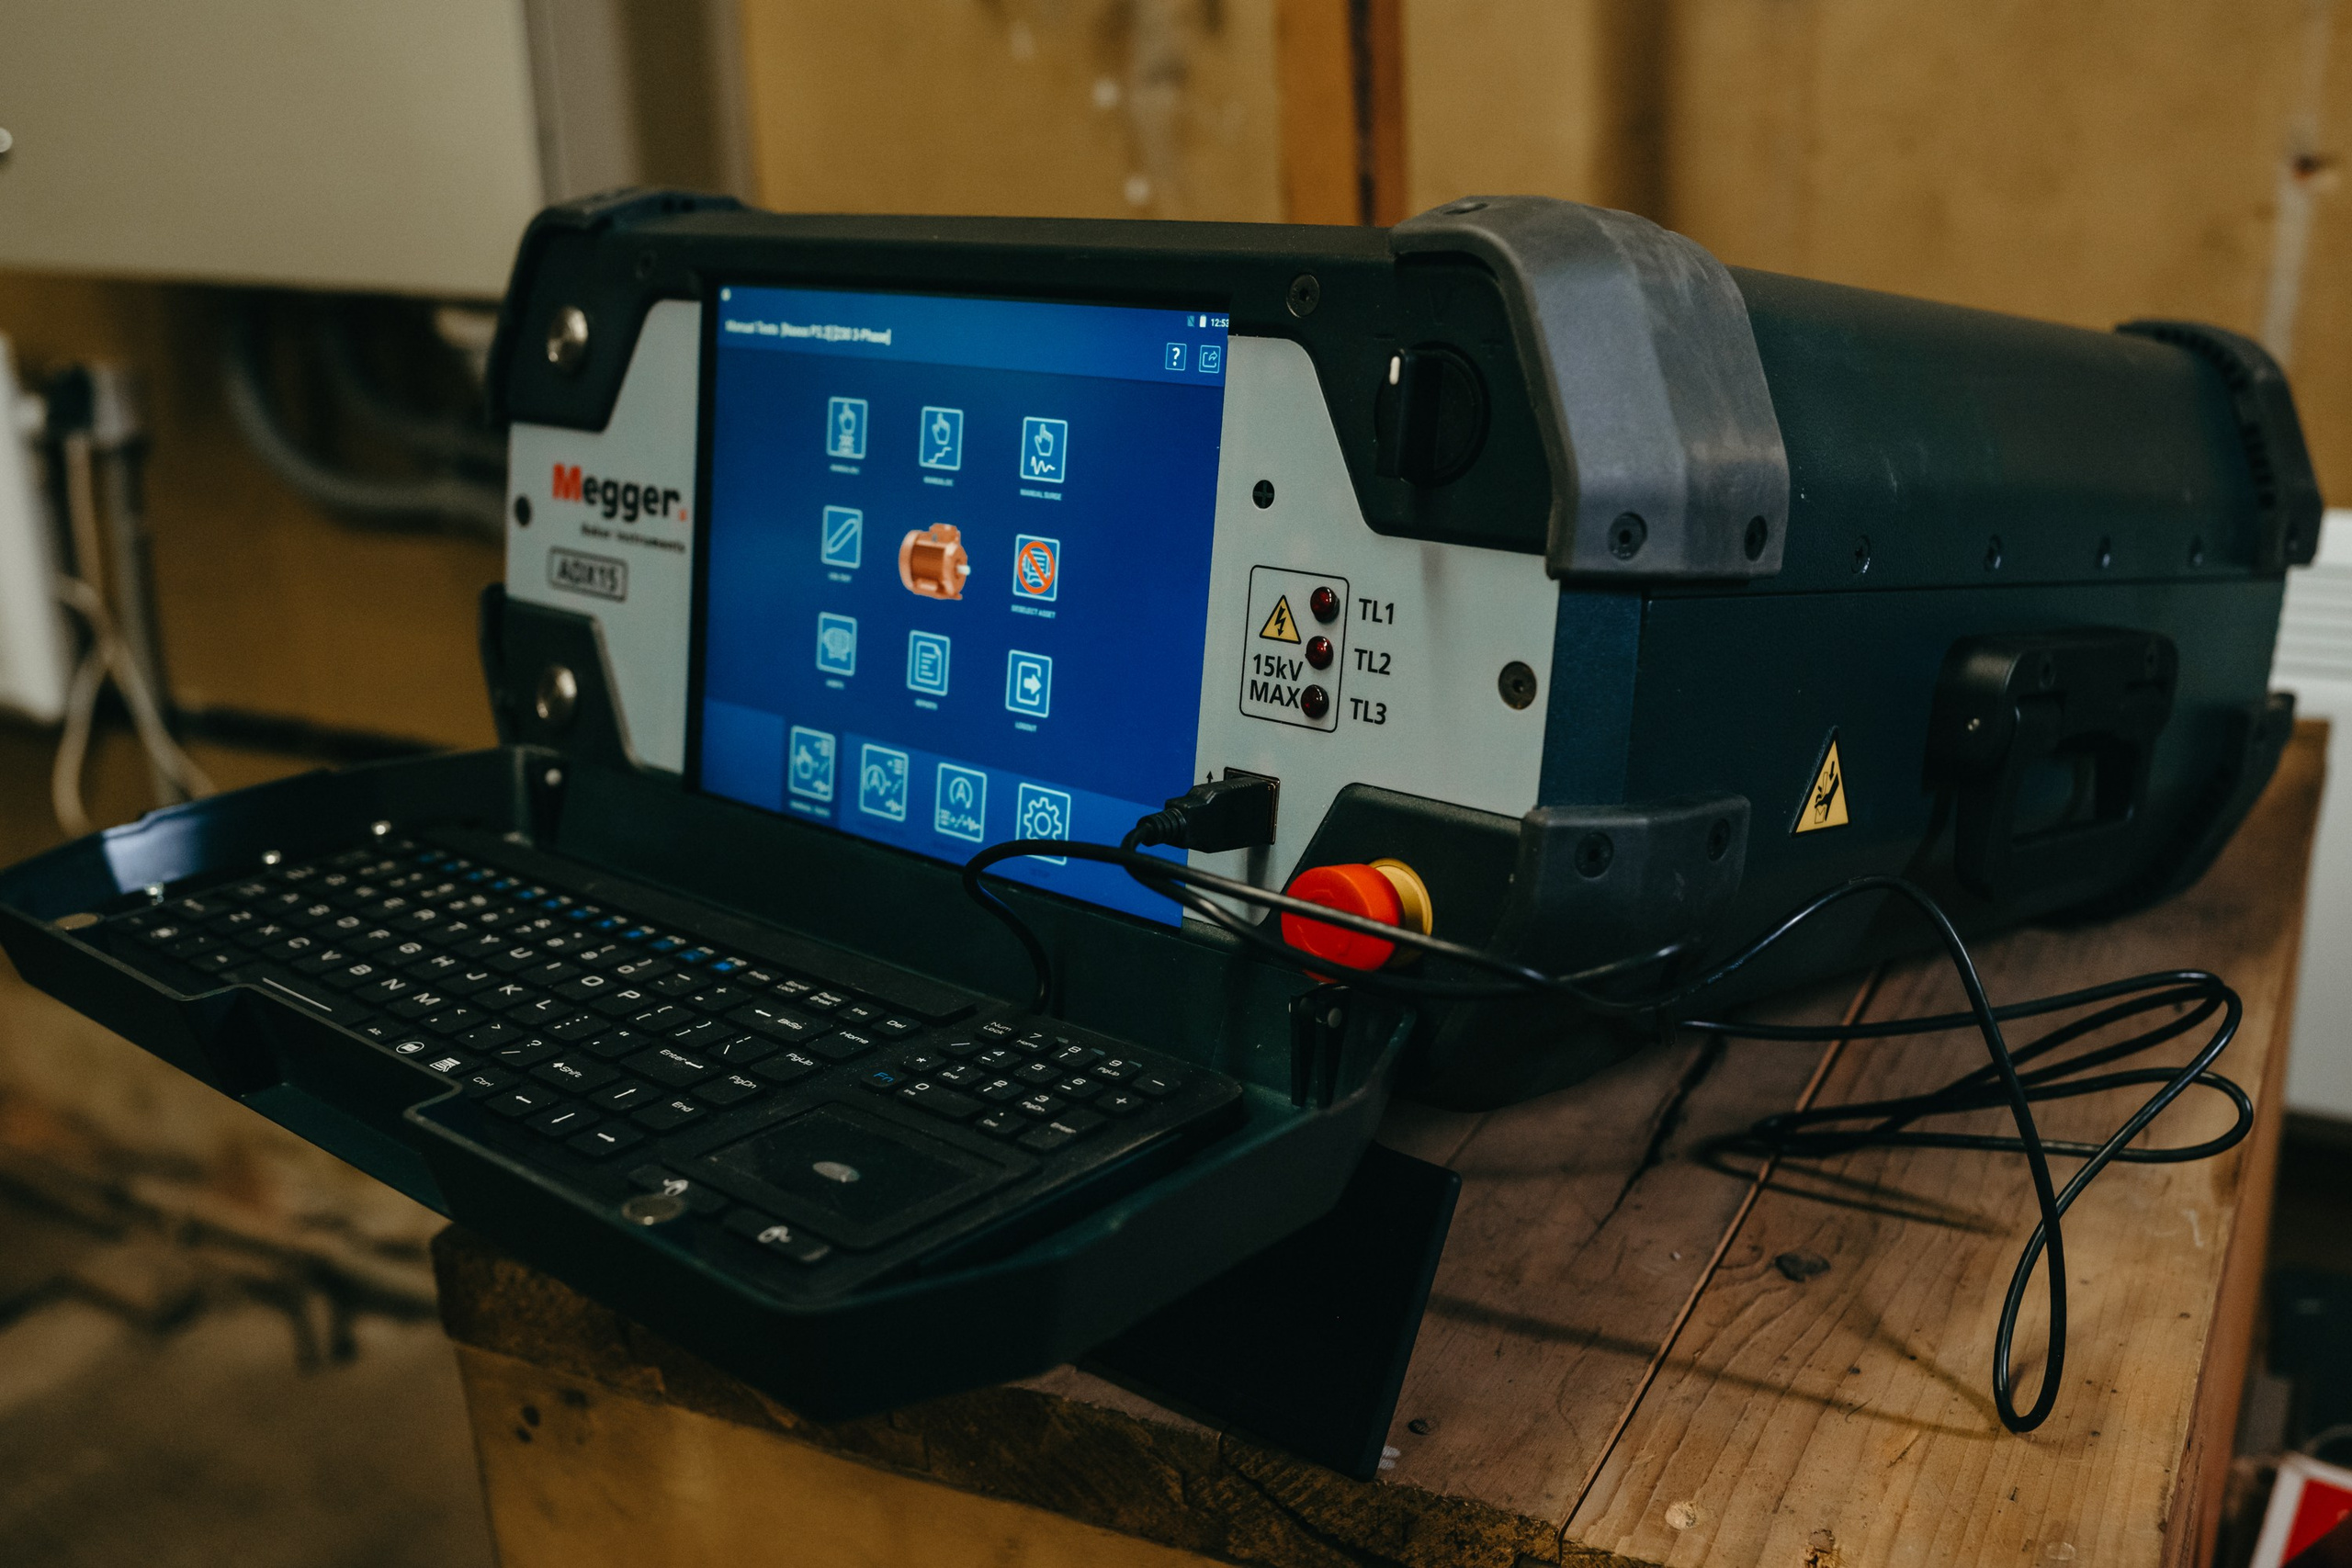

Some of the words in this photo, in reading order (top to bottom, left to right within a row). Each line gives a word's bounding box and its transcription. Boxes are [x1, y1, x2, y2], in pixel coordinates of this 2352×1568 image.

[1211, 319, 1228, 327] 12:53
[1359, 598, 1395, 625] TL1
[1354, 648, 1391, 675] TL2
[1253, 653, 1303, 682] 15kV
[1250, 679, 1301, 709] MAX
[1350, 697, 1387, 725] TL3
[481, 934, 499, 943] Y
[400, 942, 422, 953] G
[510, 948, 533, 958] U
[322, 951, 341, 960] V
[432, 956, 455, 967] H
[349, 964, 372, 976] B
[381, 978, 405, 990] N
[499, 985, 523, 995] K
[617, 990, 640, 998] P
[413, 993, 441, 1005] M
[536, 999, 551, 1010] L
[777, 1019, 802, 1030] BkSp
[983, 1025, 1005, 1035] Lock
[990, 1021, 1012, 1032] Num
[840, 1032, 868, 1043] Home
[1017, 1040, 1037, 1048] Home
[660, 1049, 686, 1062] Enter
[786, 1054, 813, 1066] PgUp
[560, 1066, 582, 1077] Shift
[874, 1072, 893, 1082] Fn
[1098, 1067, 1119, 1076] PgUp
[473, 1077, 493, 1087] Ctrl
[729, 1076, 756, 1089] PgDn
[672, 1101, 694, 1111] End
